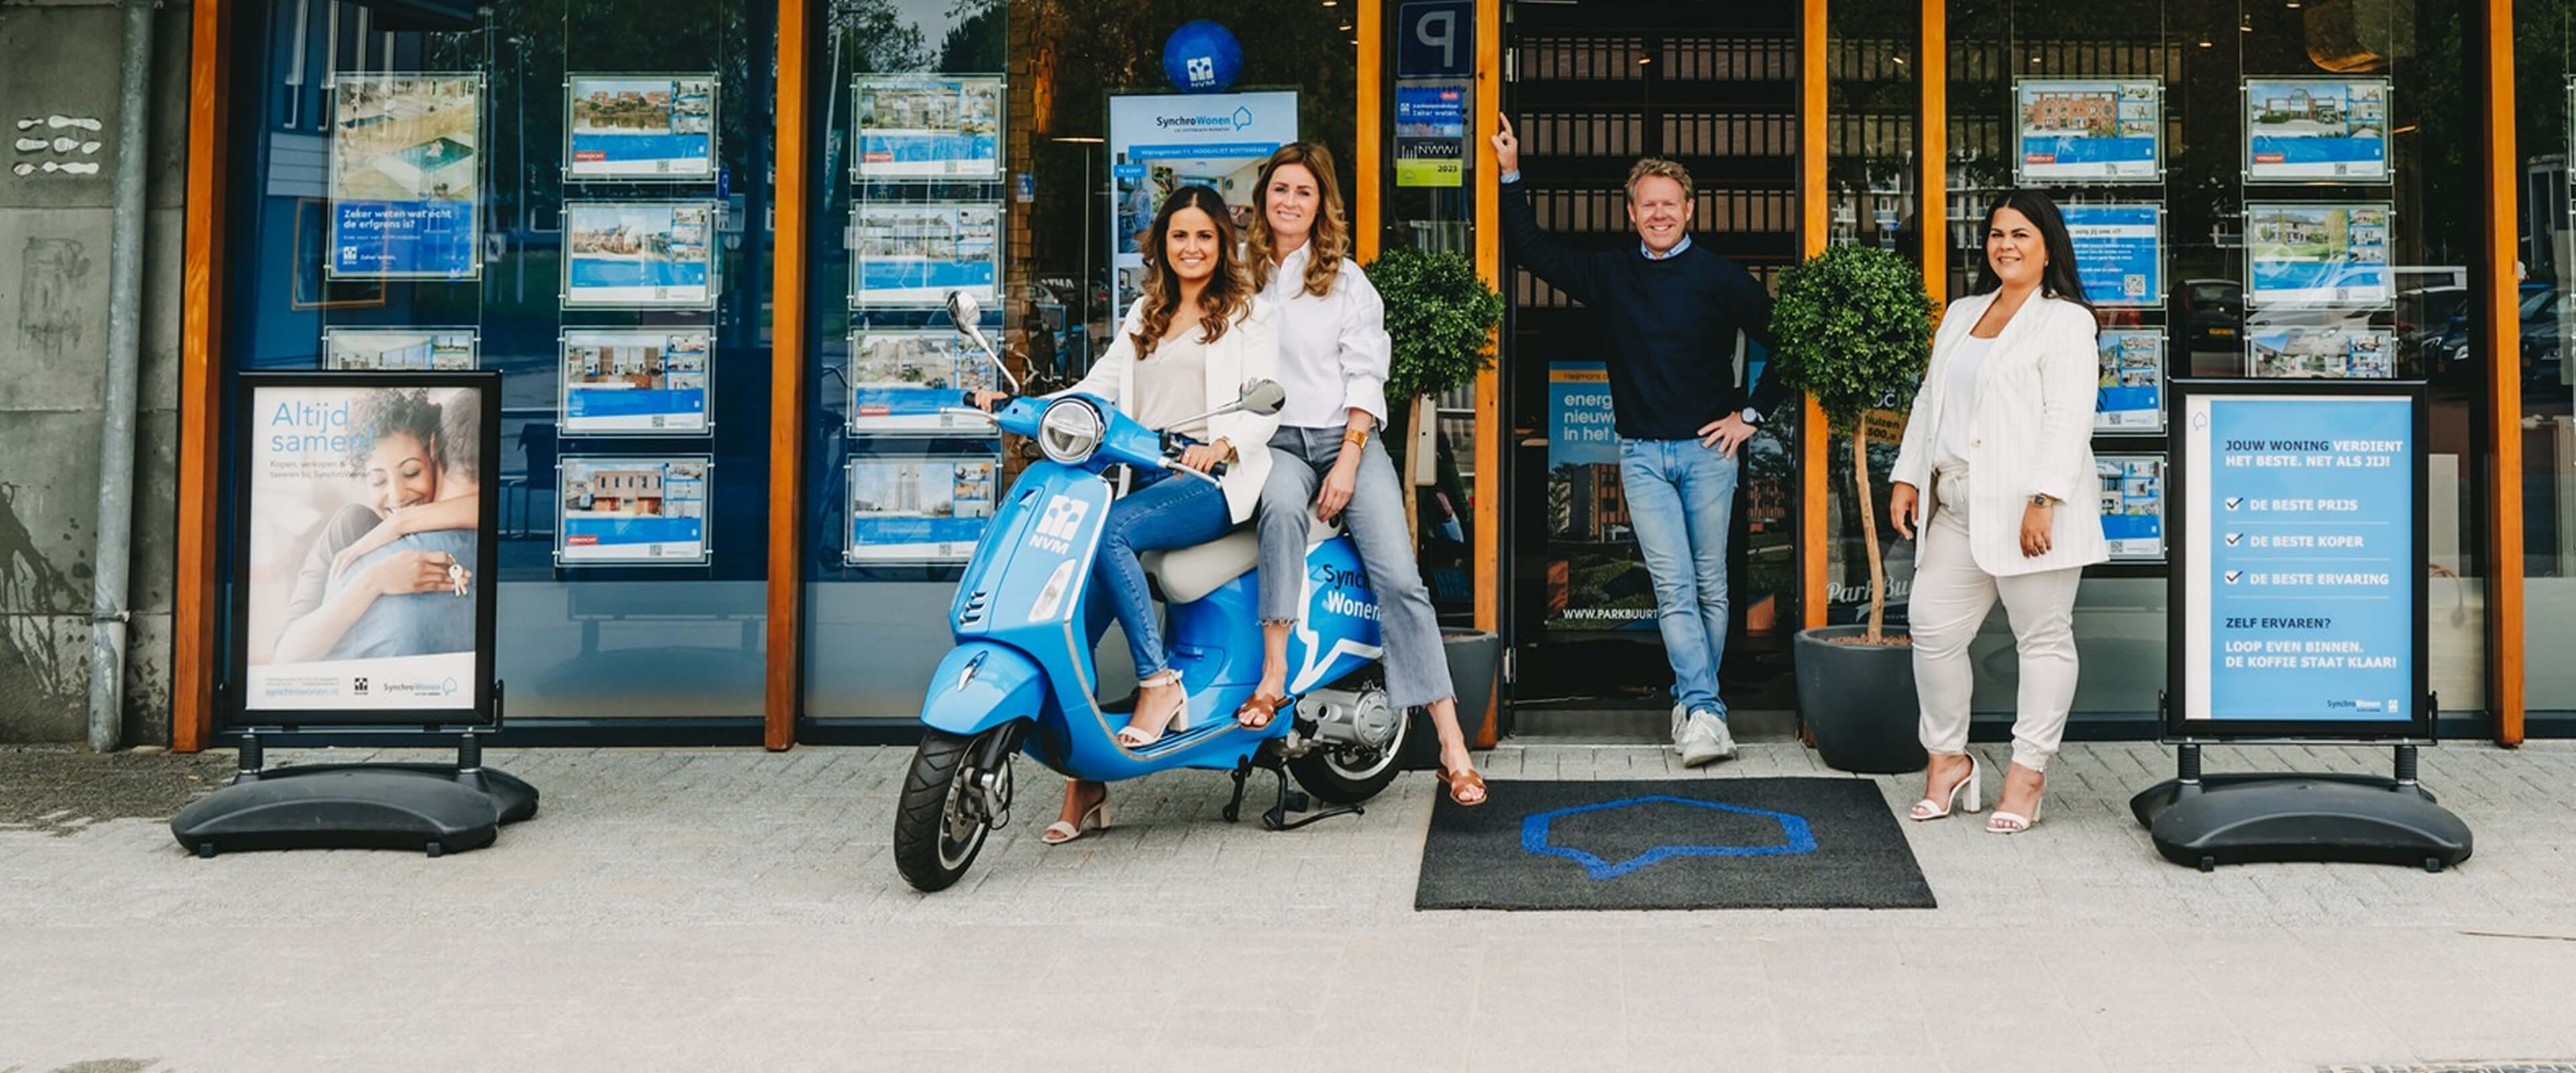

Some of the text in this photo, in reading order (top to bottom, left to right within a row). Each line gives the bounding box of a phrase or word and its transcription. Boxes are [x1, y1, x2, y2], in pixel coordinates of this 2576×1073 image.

[1191, 79, 1216, 88] NVM
[1156, 115, 1231, 129] SynchroWonen
[1418, 145, 1458, 154] NWWI
[1438, 165, 1458, 173] 2023
[344, 209, 372, 218] Zeker
[374, 209, 406, 219] weten
[407, 209, 427, 218] wat
[343, 219, 415, 231] de erfgrens is?
[1564, 394, 1613, 410] energ
[272, 400, 349, 434] Altijd
[1564, 409, 1616, 424] nieuw
[1564, 426, 1579, 441] in
[1583, 426, 1610, 441] het
[271, 427, 375, 453] samen!
[2225, 440, 2403, 452] JOUW WONING VERDIENT
[2225, 455, 2390, 467] HET BESTE. NET ALS JIJ!
[2250, 499, 2359, 511] DE BESTE PRIJS
[1028, 534, 1071, 555] NVM
[2250, 535, 2364, 547] DE BESTE KOPER
[1323, 563, 1366, 590] Sync
[2249, 573, 2390, 585] DE BESTE ERVARING
[1327, 589, 1381, 622] Wonen
[1562, 608, 1658, 619] WWW.PARKBUURT
[2225, 618, 2332, 629] ZELF ERVAREN?
[2225, 640, 2364, 653] LOOP EVEN BINNEN.
[2225, 657, 2397, 668] DE KOFFIE STAAT KLAAR!
